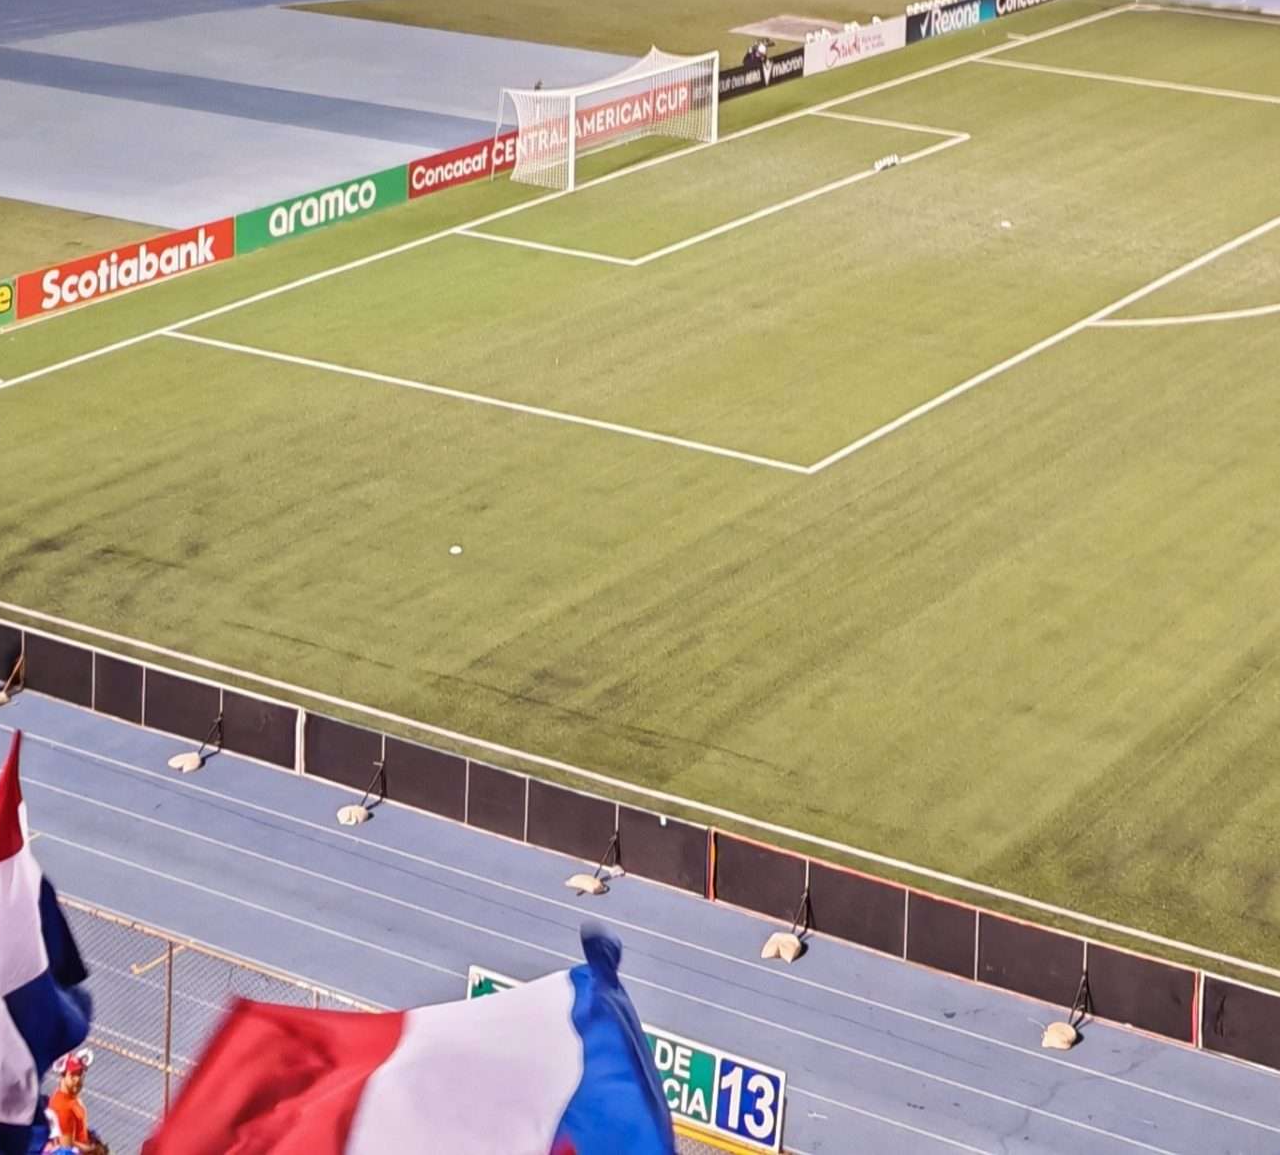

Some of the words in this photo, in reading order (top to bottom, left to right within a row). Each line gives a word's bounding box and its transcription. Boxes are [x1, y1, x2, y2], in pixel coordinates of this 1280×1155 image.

[931, 1, 981, 36] Rexona
[772, 57, 804, 78] macron
[412, 145, 488, 191] Concacaf
[492, 125, 567, 165] CENTRAL
[573, 105, 653, 139] AMERICAN
[656, 86, 689, 114] CUP
[269, 179, 377, 237] aramco
[41, 228, 215, 310] Scotiabank
[654, 1038, 693, 1080] DE
[720, 1065, 776, 1139] 13
